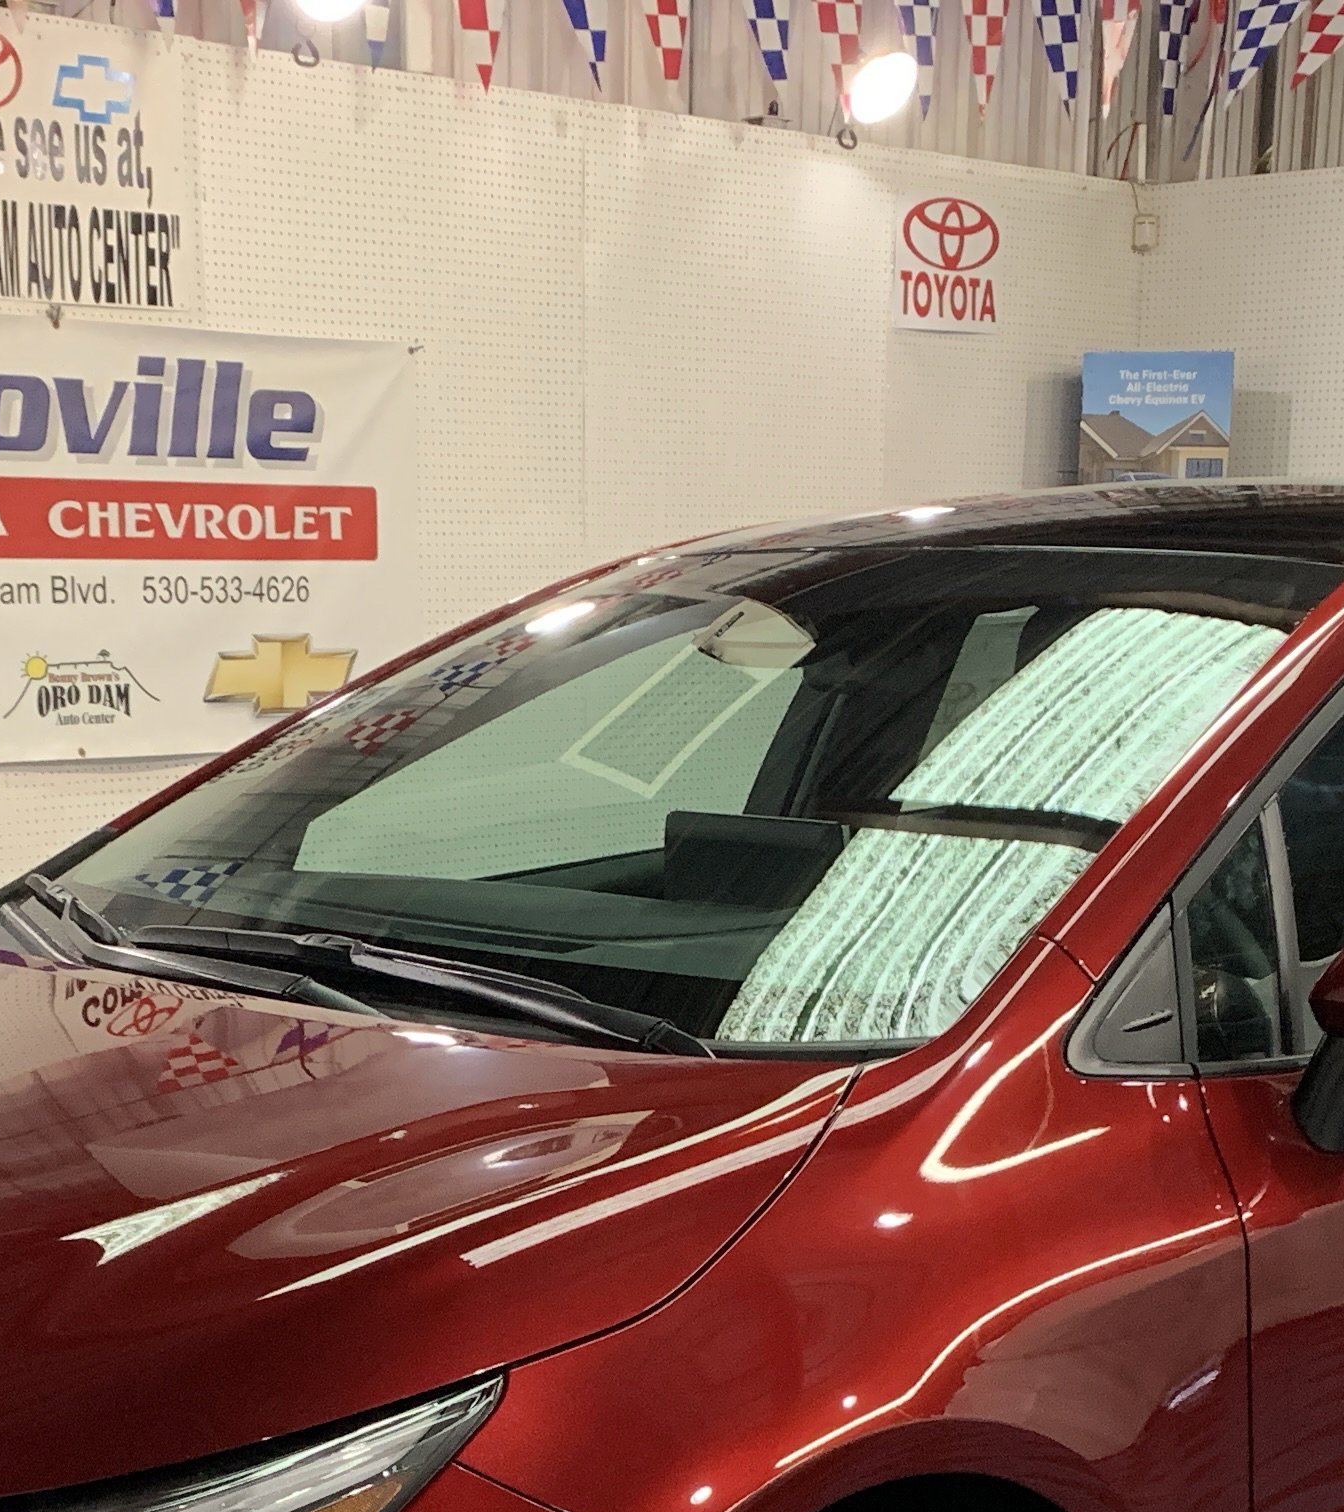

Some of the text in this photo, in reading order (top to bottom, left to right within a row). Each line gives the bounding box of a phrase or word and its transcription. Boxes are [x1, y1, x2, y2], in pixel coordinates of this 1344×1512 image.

[14, 116, 65, 181] see
[73, 122, 108, 186] us
[28, 201, 82, 303] AUTO
[900, 270, 996, 323] TOYOTA
[1119, 369, 1197, 380] The First-Ever
[1108, 394, 1143, 406] Chevy
[1191, 394, 1206, 404] EV
[47, 498, 353, 542] CHEVROLET
[50, 575, 116, 606] Blvd.
[141, 575, 310, 605] 530-533-4626
[37, 683, 132, 718] ORO DAM
[56, 712, 116, 726] Auto Center
